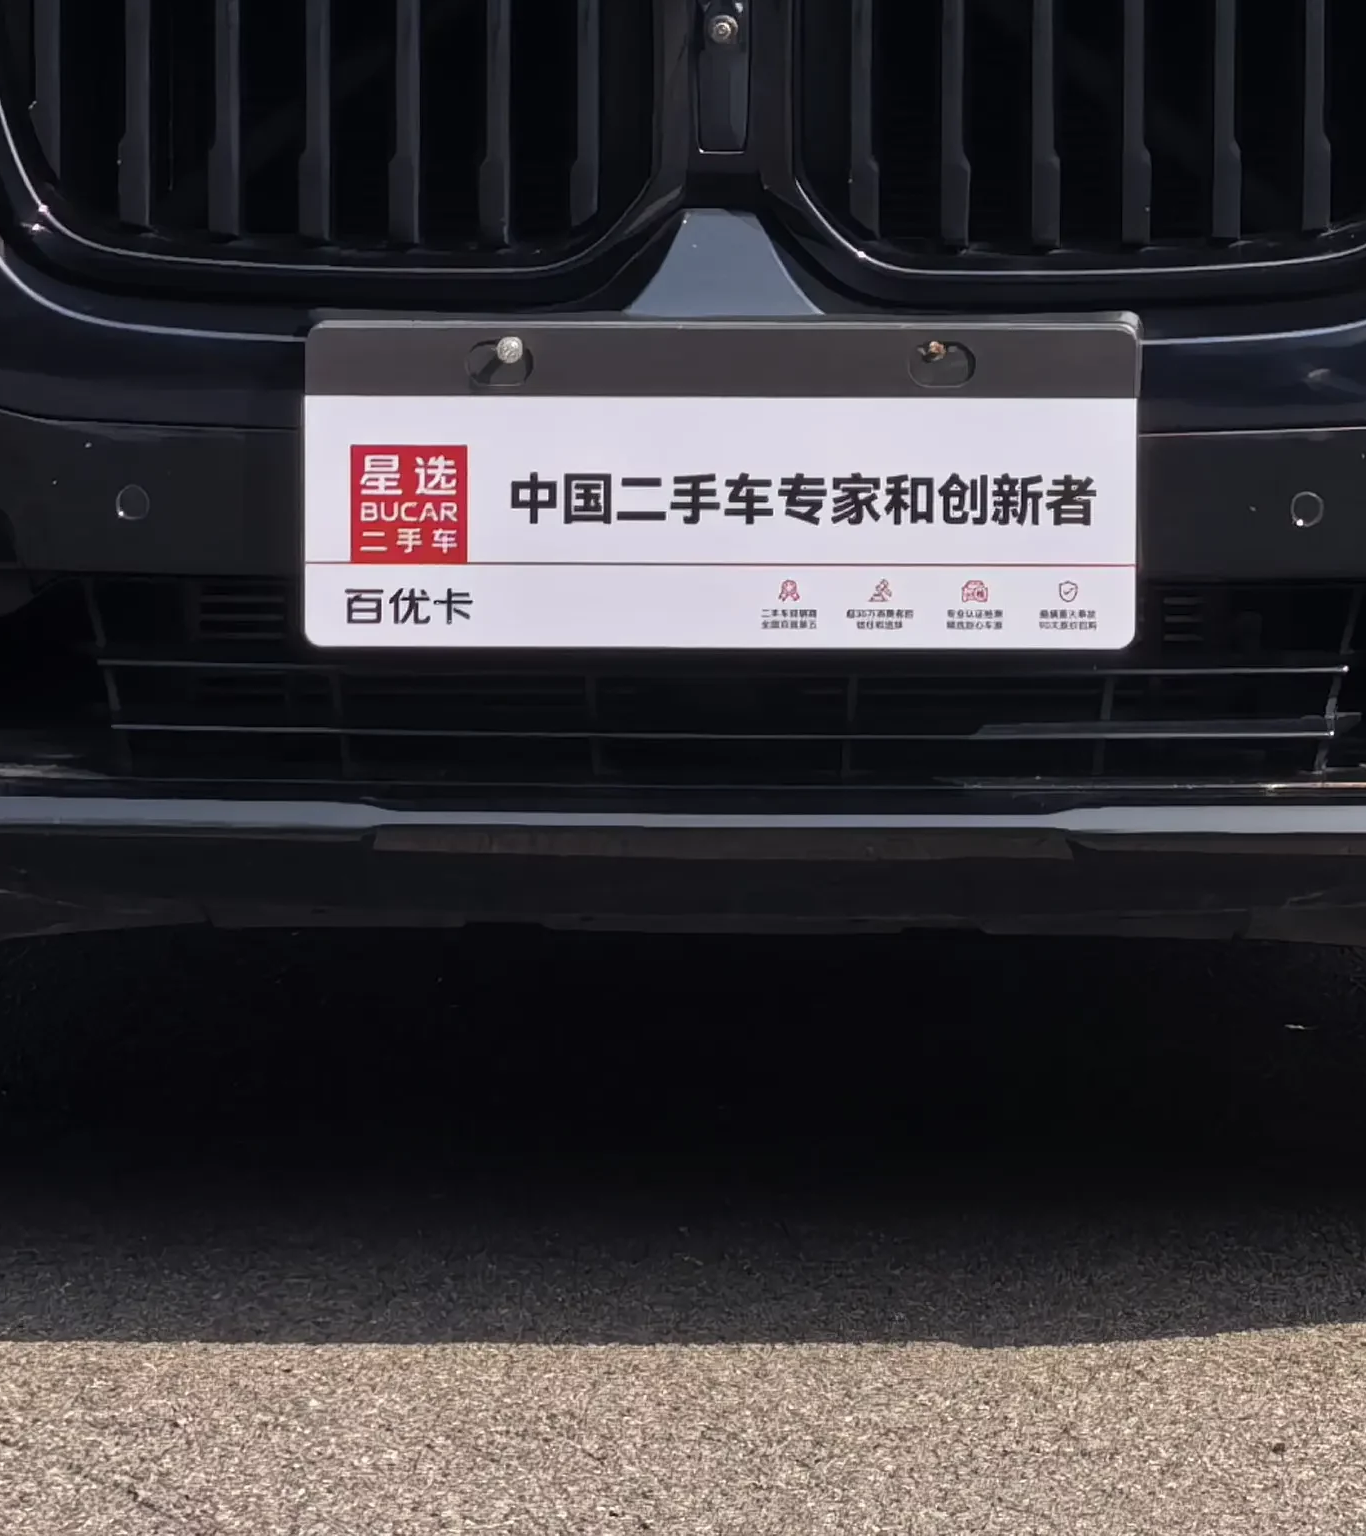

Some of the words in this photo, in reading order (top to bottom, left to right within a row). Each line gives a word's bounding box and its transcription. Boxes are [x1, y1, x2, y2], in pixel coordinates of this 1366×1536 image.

[360, 454, 457, 496] 星选
[360, 501, 458, 522] BUCAR
[509, 471, 1098, 527] 中国二手车专家和创新者
[360, 527, 457, 554] 二手车
[344, 587, 474, 626] 百优卡
